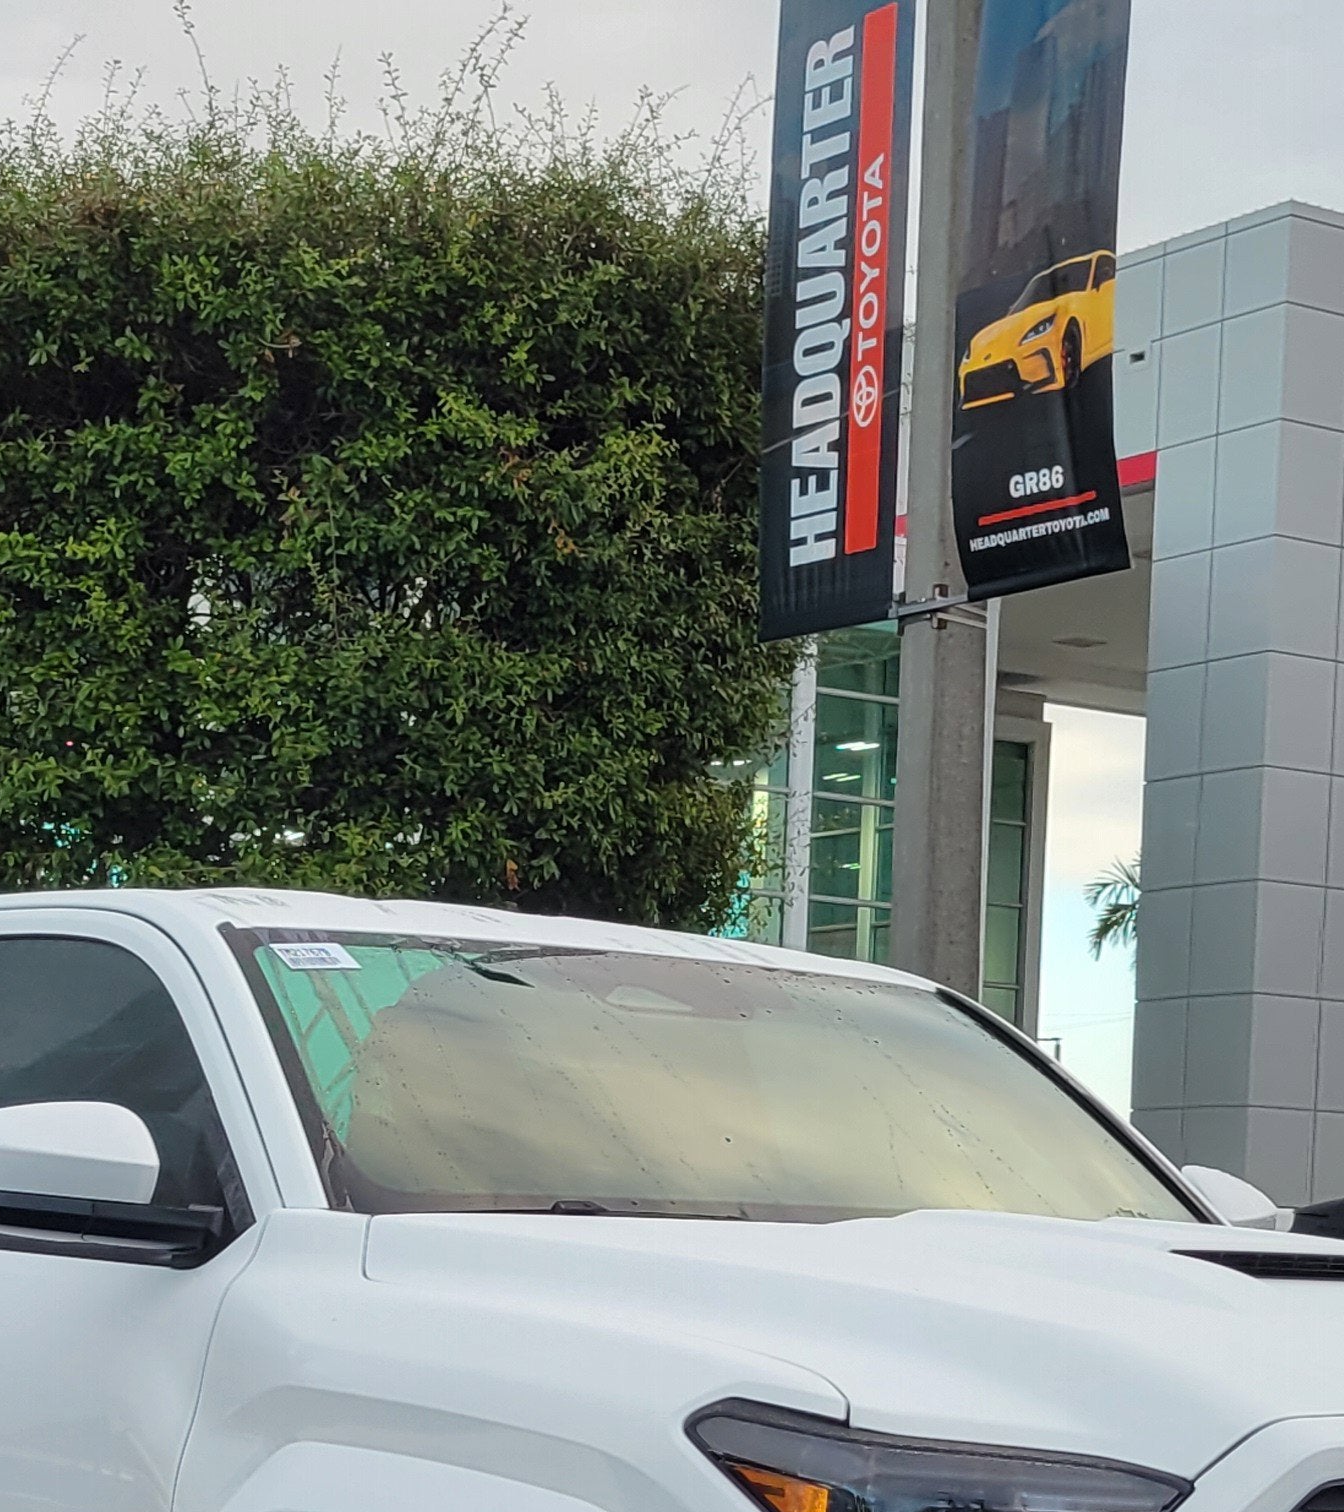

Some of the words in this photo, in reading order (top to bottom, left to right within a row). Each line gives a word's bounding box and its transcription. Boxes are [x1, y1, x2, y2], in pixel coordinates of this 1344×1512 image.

[790, 24, 855, 567] HEADQUARTER
[858, 152, 885, 362] TOYOTA
[1009, 465, 1064, 498] GR86
